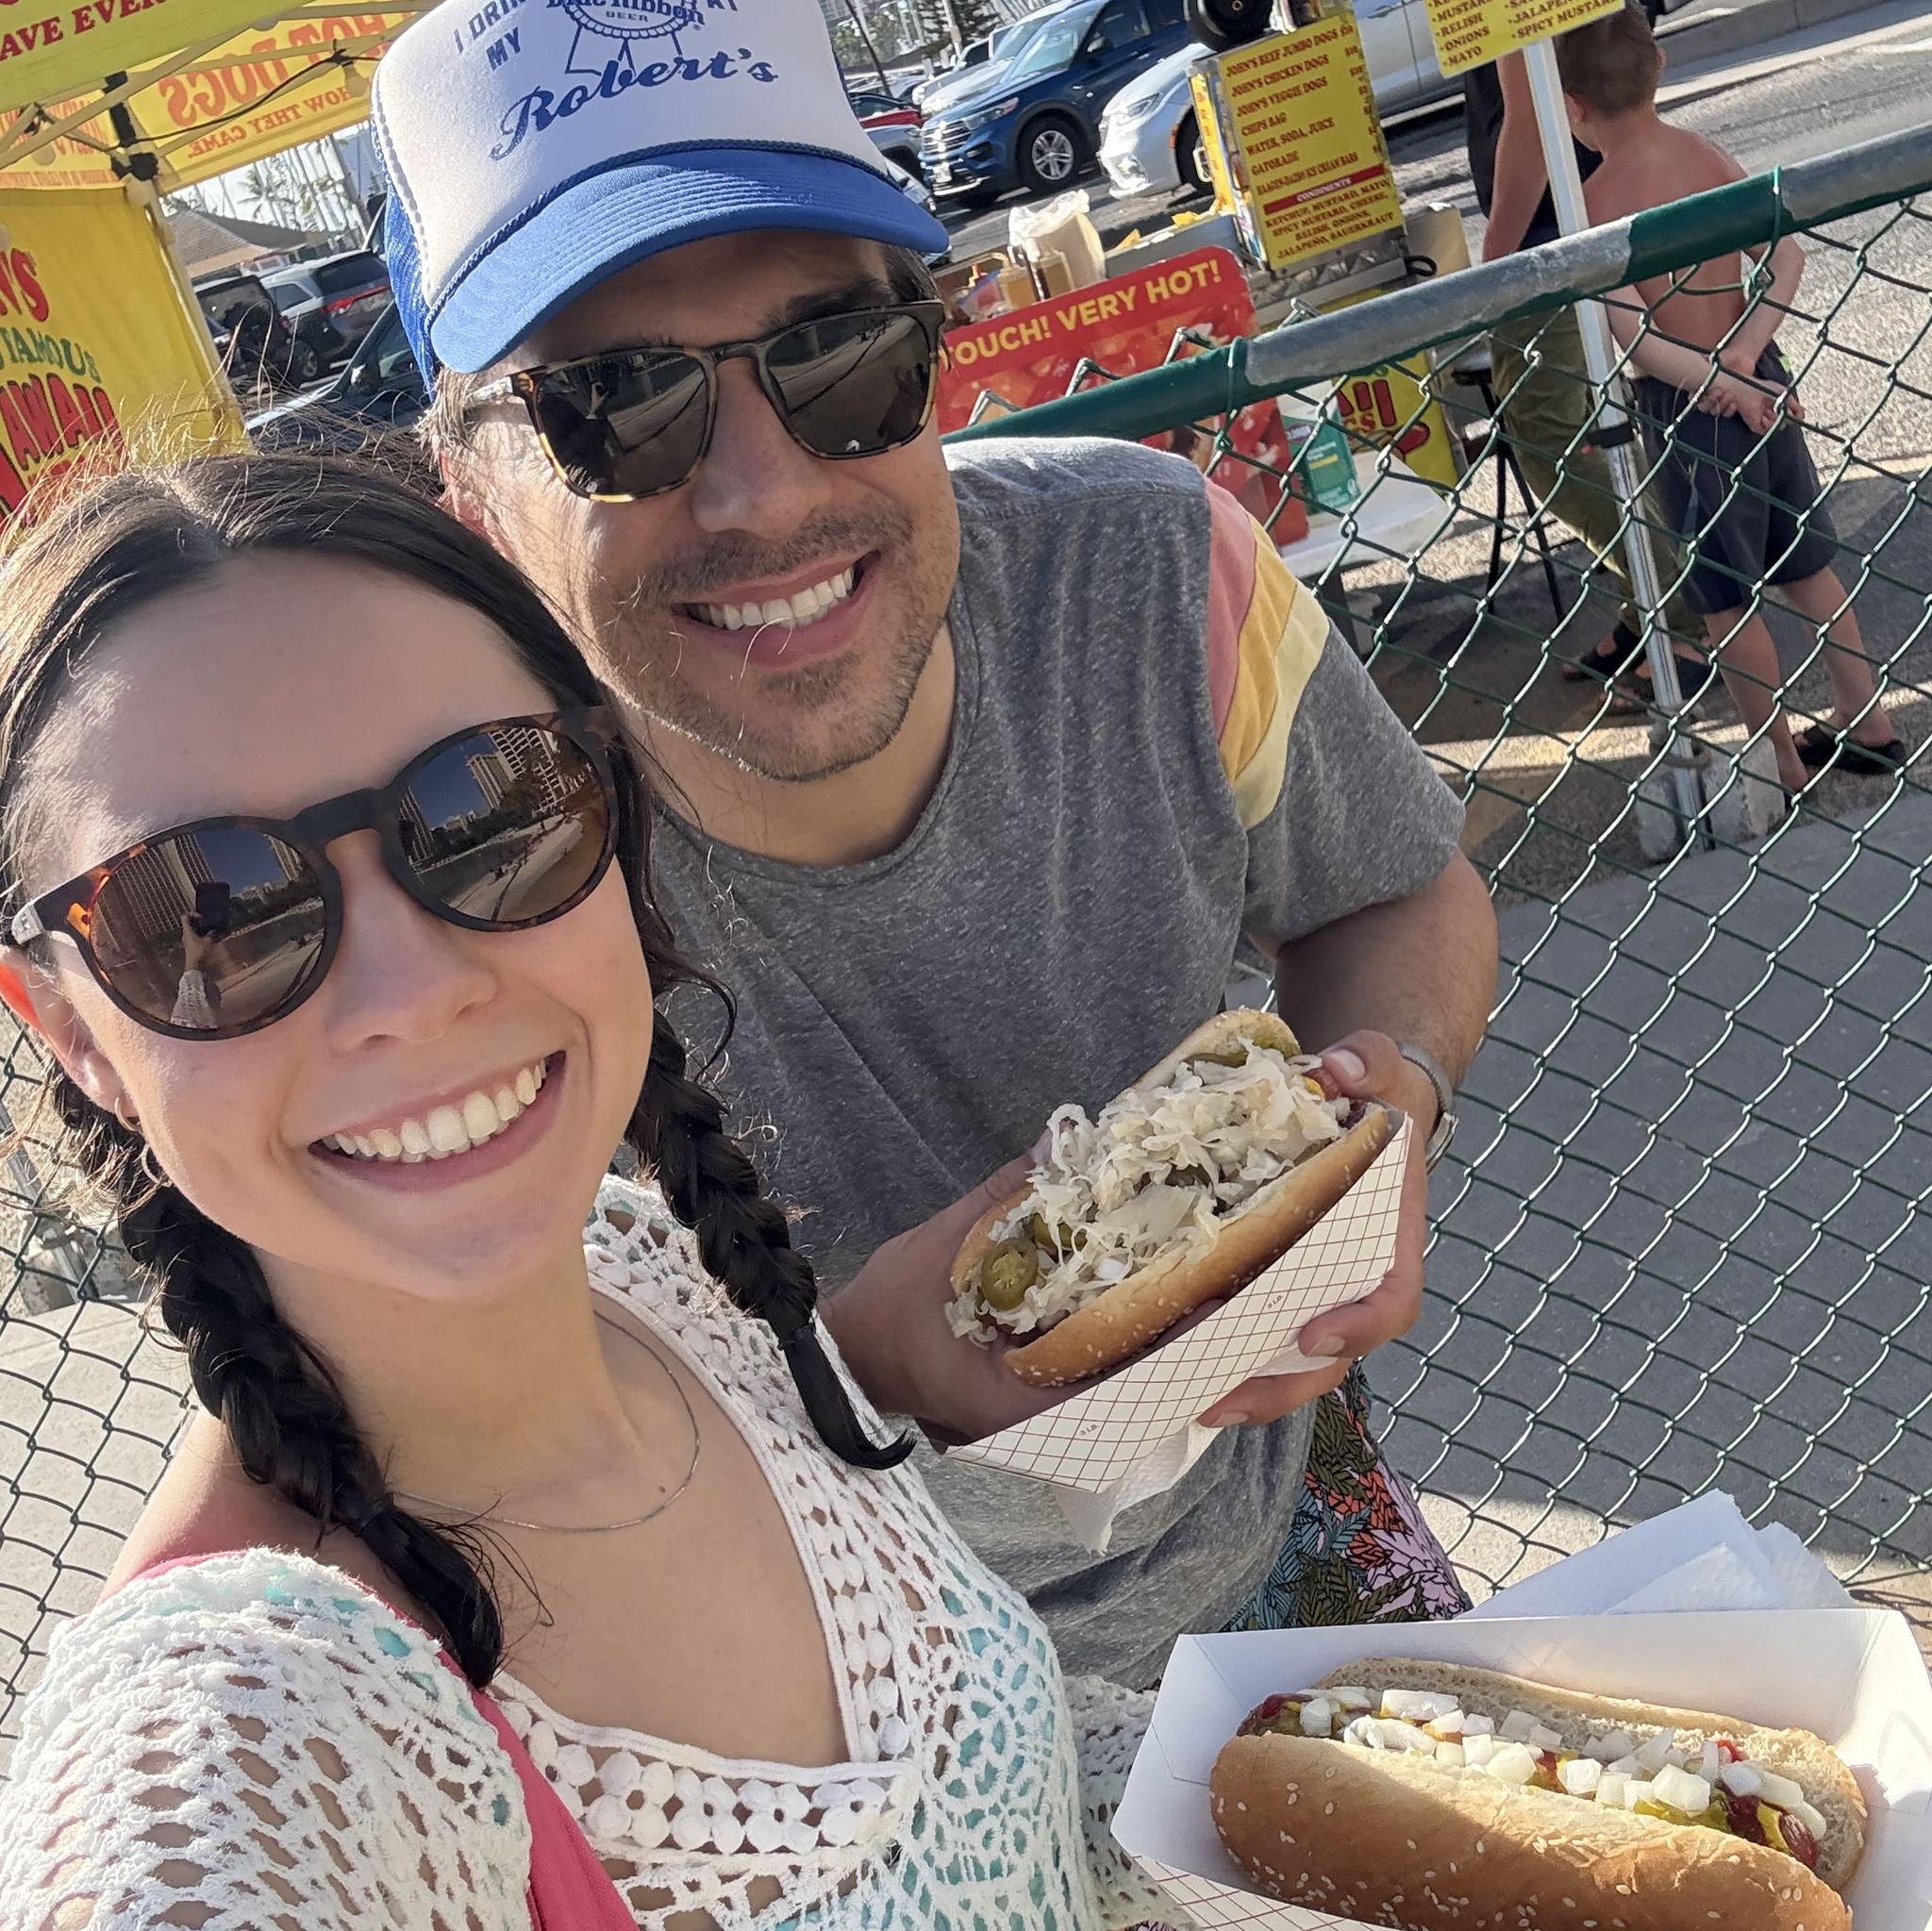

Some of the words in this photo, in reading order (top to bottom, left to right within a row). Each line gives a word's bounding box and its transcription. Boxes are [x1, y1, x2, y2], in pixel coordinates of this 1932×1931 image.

[606, 10, 649, 22] BEER
[1441, 12, 1484, 37] RELISH
[1517, 16, 1555, 38] SPICY
[454, 28, 464, 54] I
[486, 26, 521, 72] MY
[1312, 29, 1338, 45] DOGS
[1444, 25, 1490, 51] ONIONS
[1447, 45, 1482, 67] MAYO
[1263, 62, 1304, 86] CHICKEN
[1304, 54, 1329, 71] DOGS
[1302, 75, 1327, 92] DOGS
[490, 47, 778, 161] Robert's
[1307, 117, 1334, 135] JUICE
[954, 314, 1052, 365] OUCH!
[1055, 285, 1138, 332] VERY
[1145, 258, 1223, 305] HOT!
